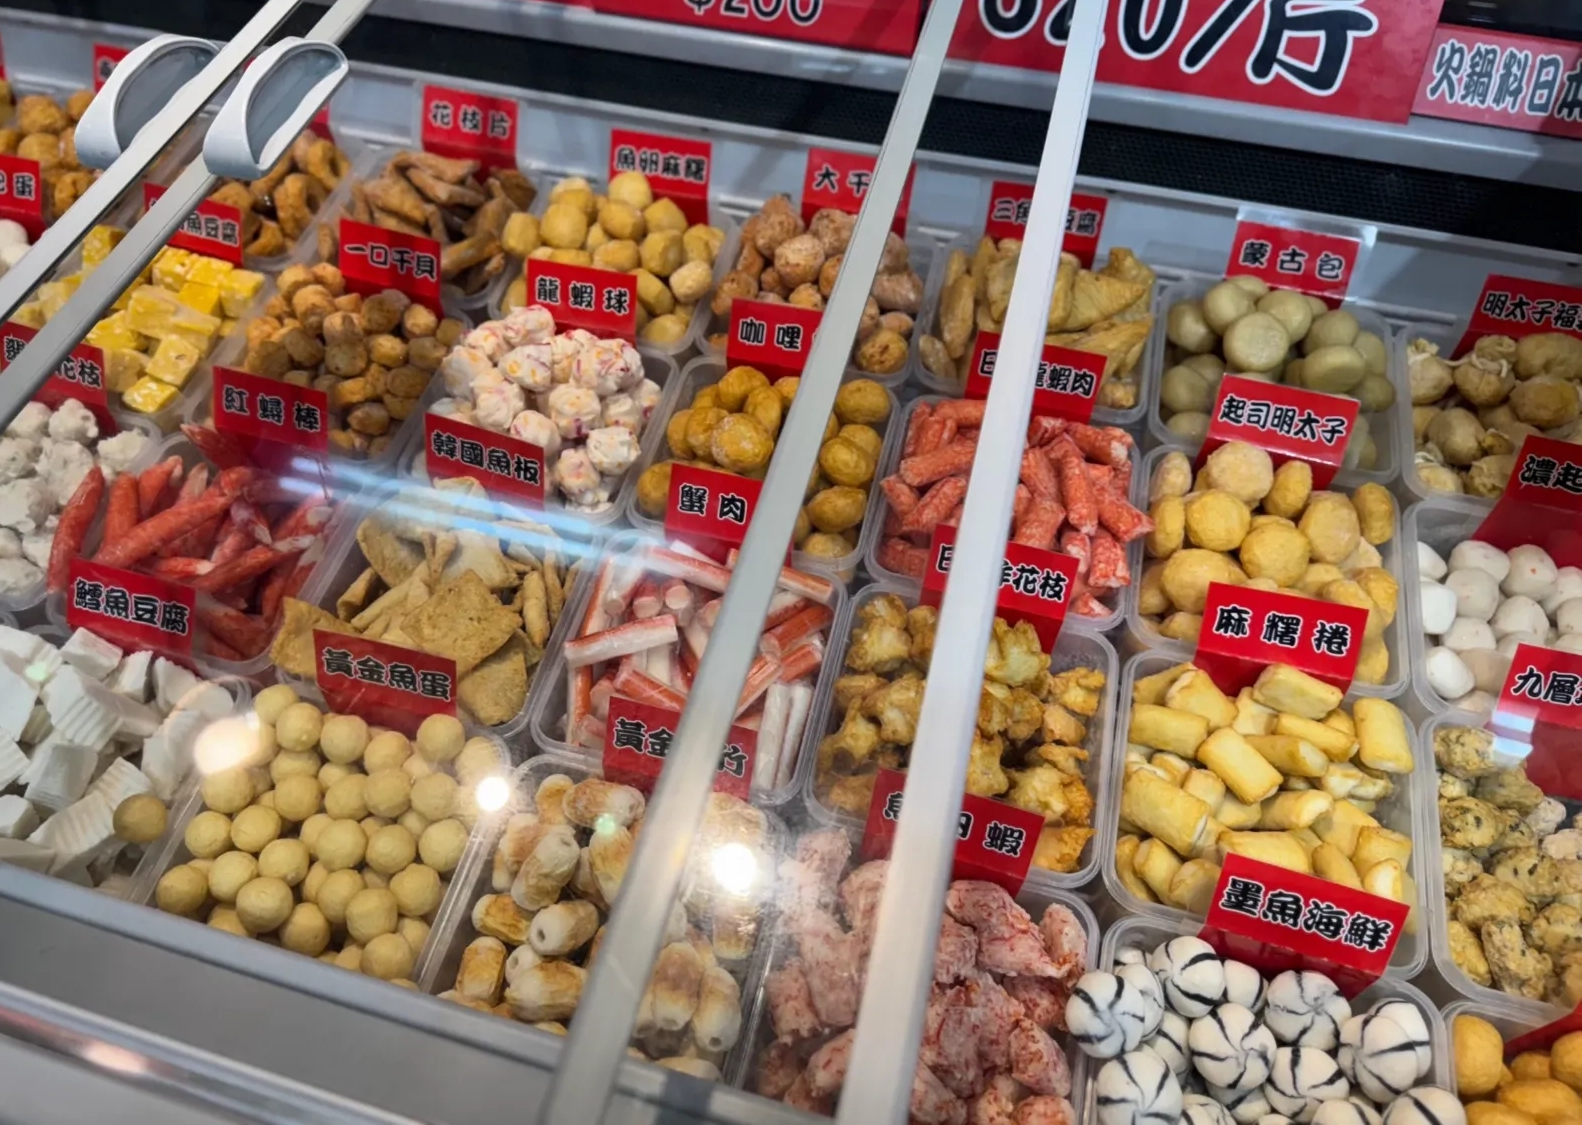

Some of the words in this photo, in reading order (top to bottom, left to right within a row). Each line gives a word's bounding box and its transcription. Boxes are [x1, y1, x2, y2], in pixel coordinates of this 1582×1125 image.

[428, 98, 515, 138] 花枝片
[344, 241, 437, 282] 一口干貝
[1238, 238, 1345, 282] 蒙古包
[534, 275, 631, 316] 龍蝦球
[1481, 291, 1582, 331] 明太子福
[737, 317, 817, 353] 咖哩
[222, 385, 321, 434] 紅蟳棒
[1219, 393, 1348, 446] 起司明太子
[430, 429, 542, 488] 韓國魚板
[72, 578, 190, 636] 鱈魚豆腐
[1212, 604, 1352, 656] 麻糬捲
[322, 645, 452, 701] 黃金魚蛋
[1511, 664, 1582, 708] 九層
[1221, 876, 1394, 953] 墨魚海鮮
